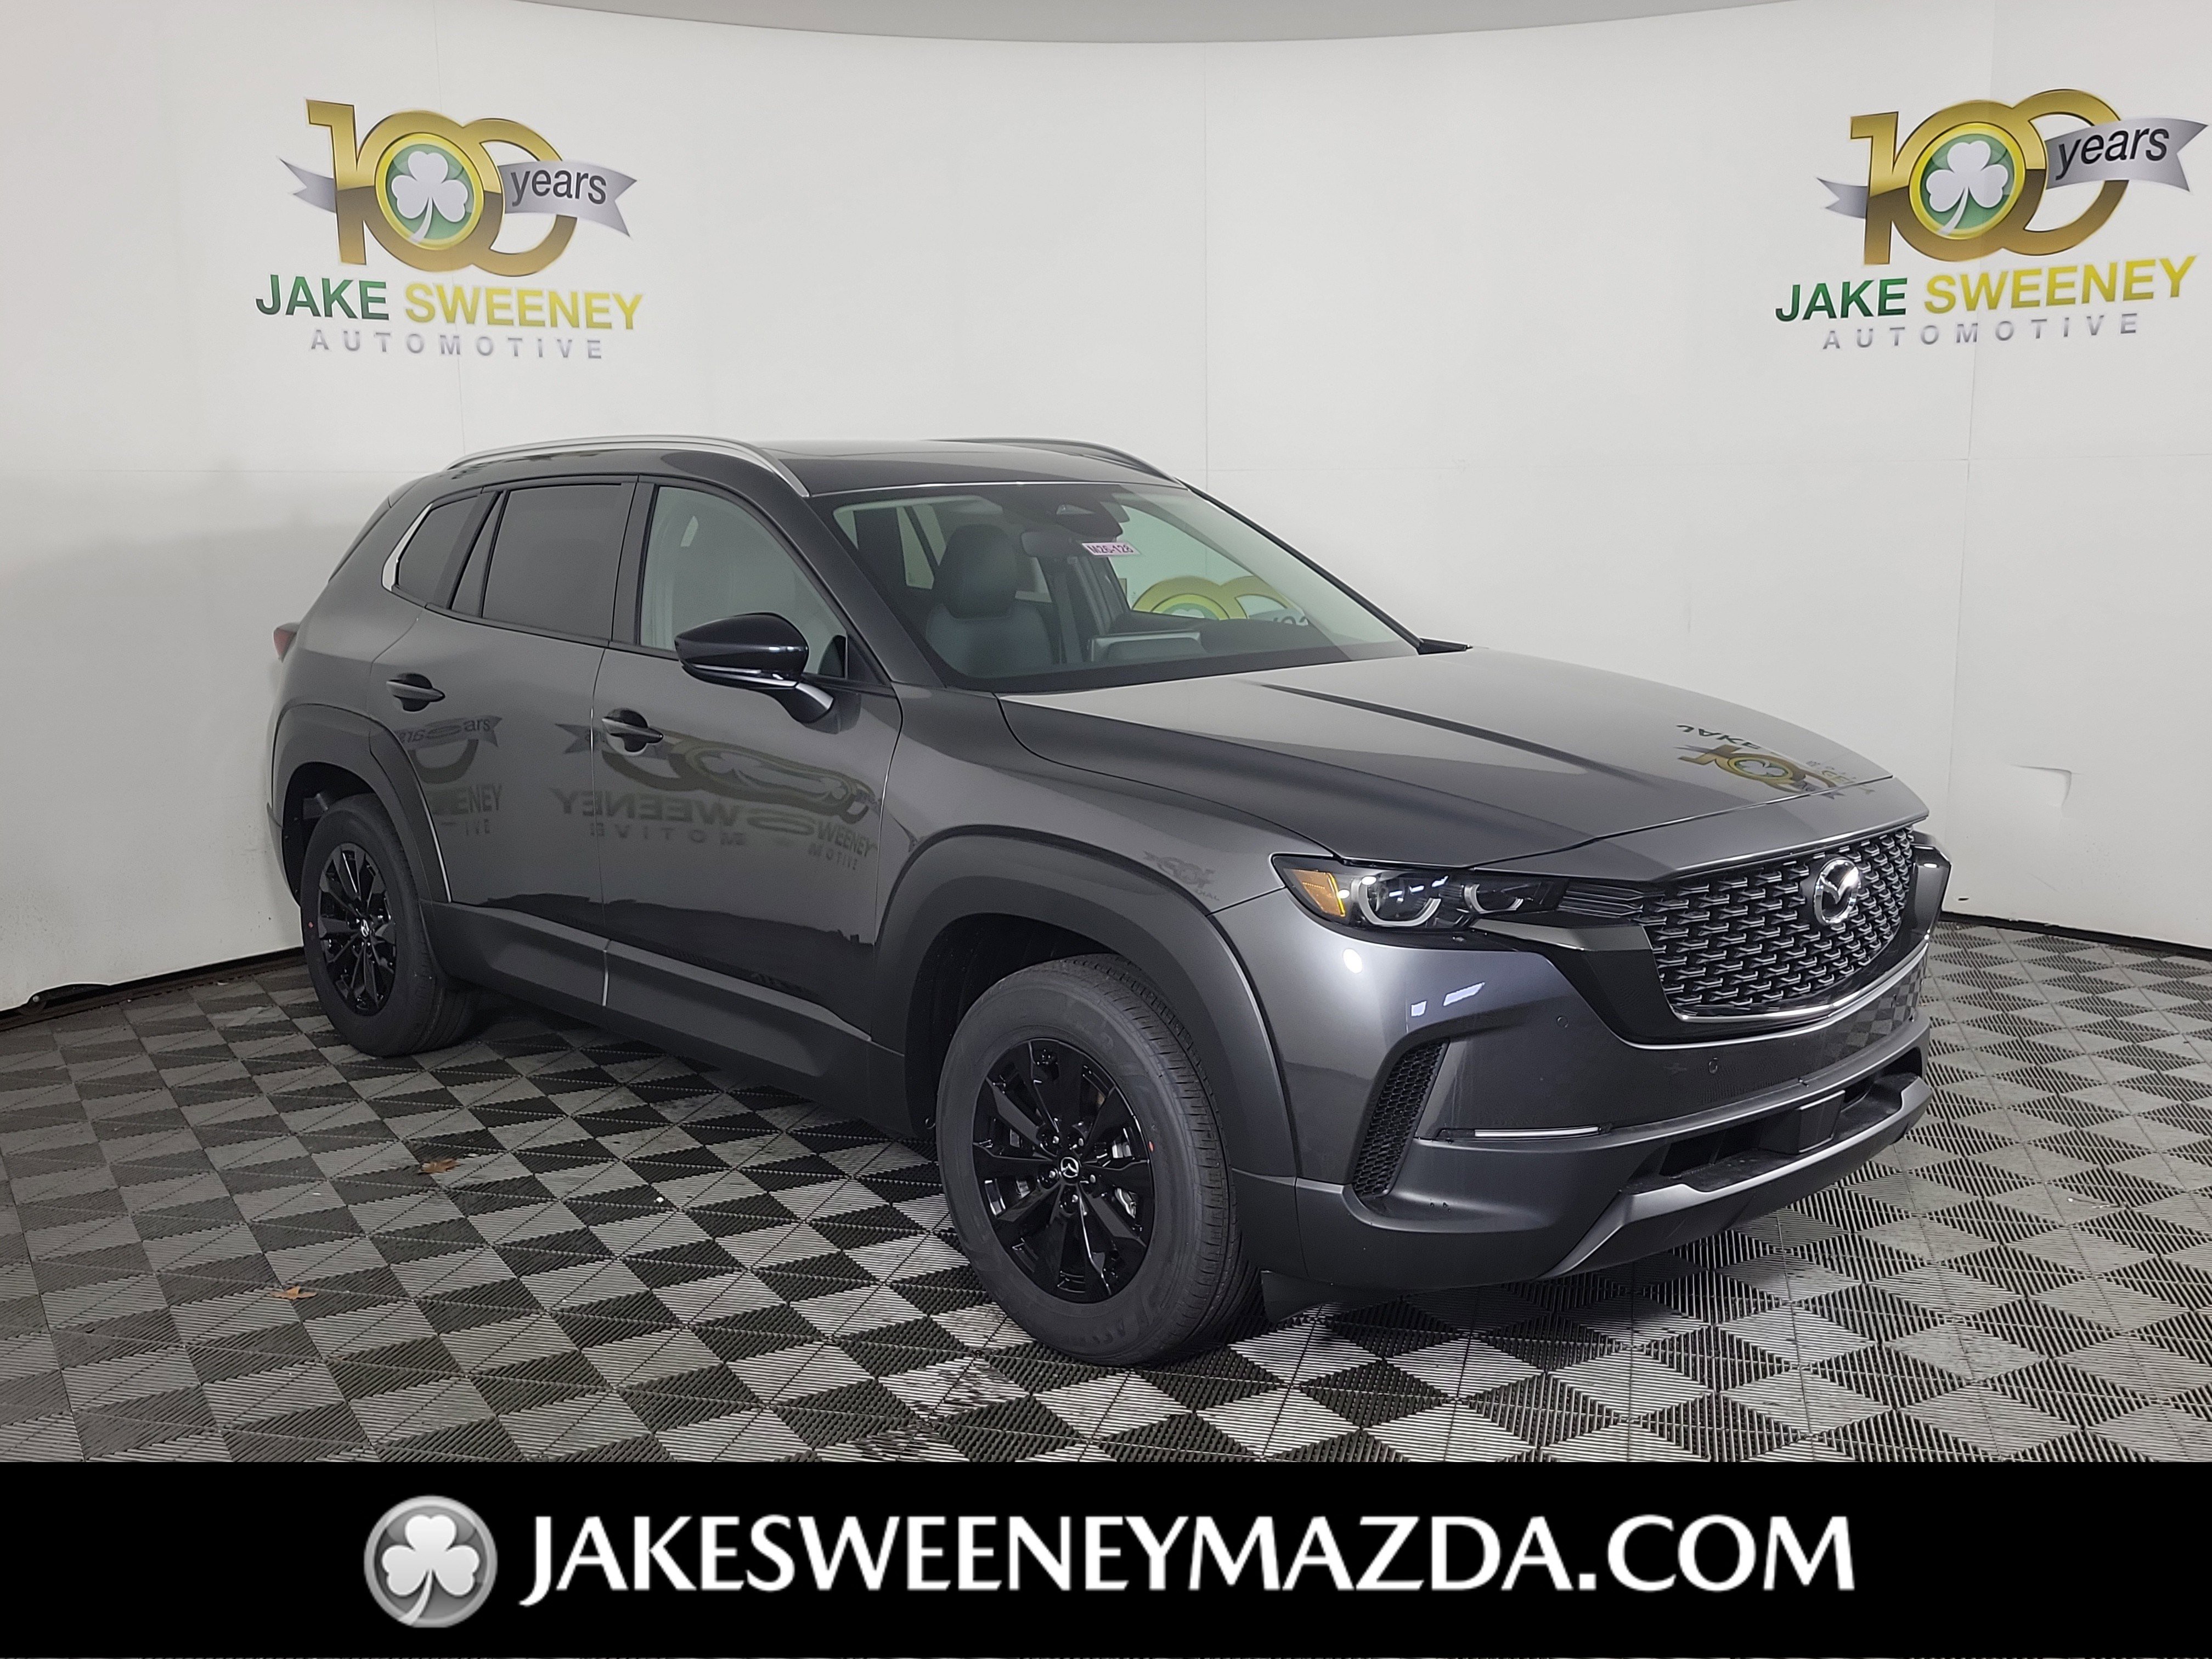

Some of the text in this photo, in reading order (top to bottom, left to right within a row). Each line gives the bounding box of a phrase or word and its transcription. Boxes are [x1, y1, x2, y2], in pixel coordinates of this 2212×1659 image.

[306, 98, 607, 277] 100 years
[1850, 88, 2170, 266] 100 years
[255, 274, 643, 329] JAKE SWEENEY
[1775, 255, 2197, 321] JAKE SWEENEY
[311, 329, 602, 359] AUTOMOTIVE
[1822, 313, 2138, 350] AUTOMOTIVE
